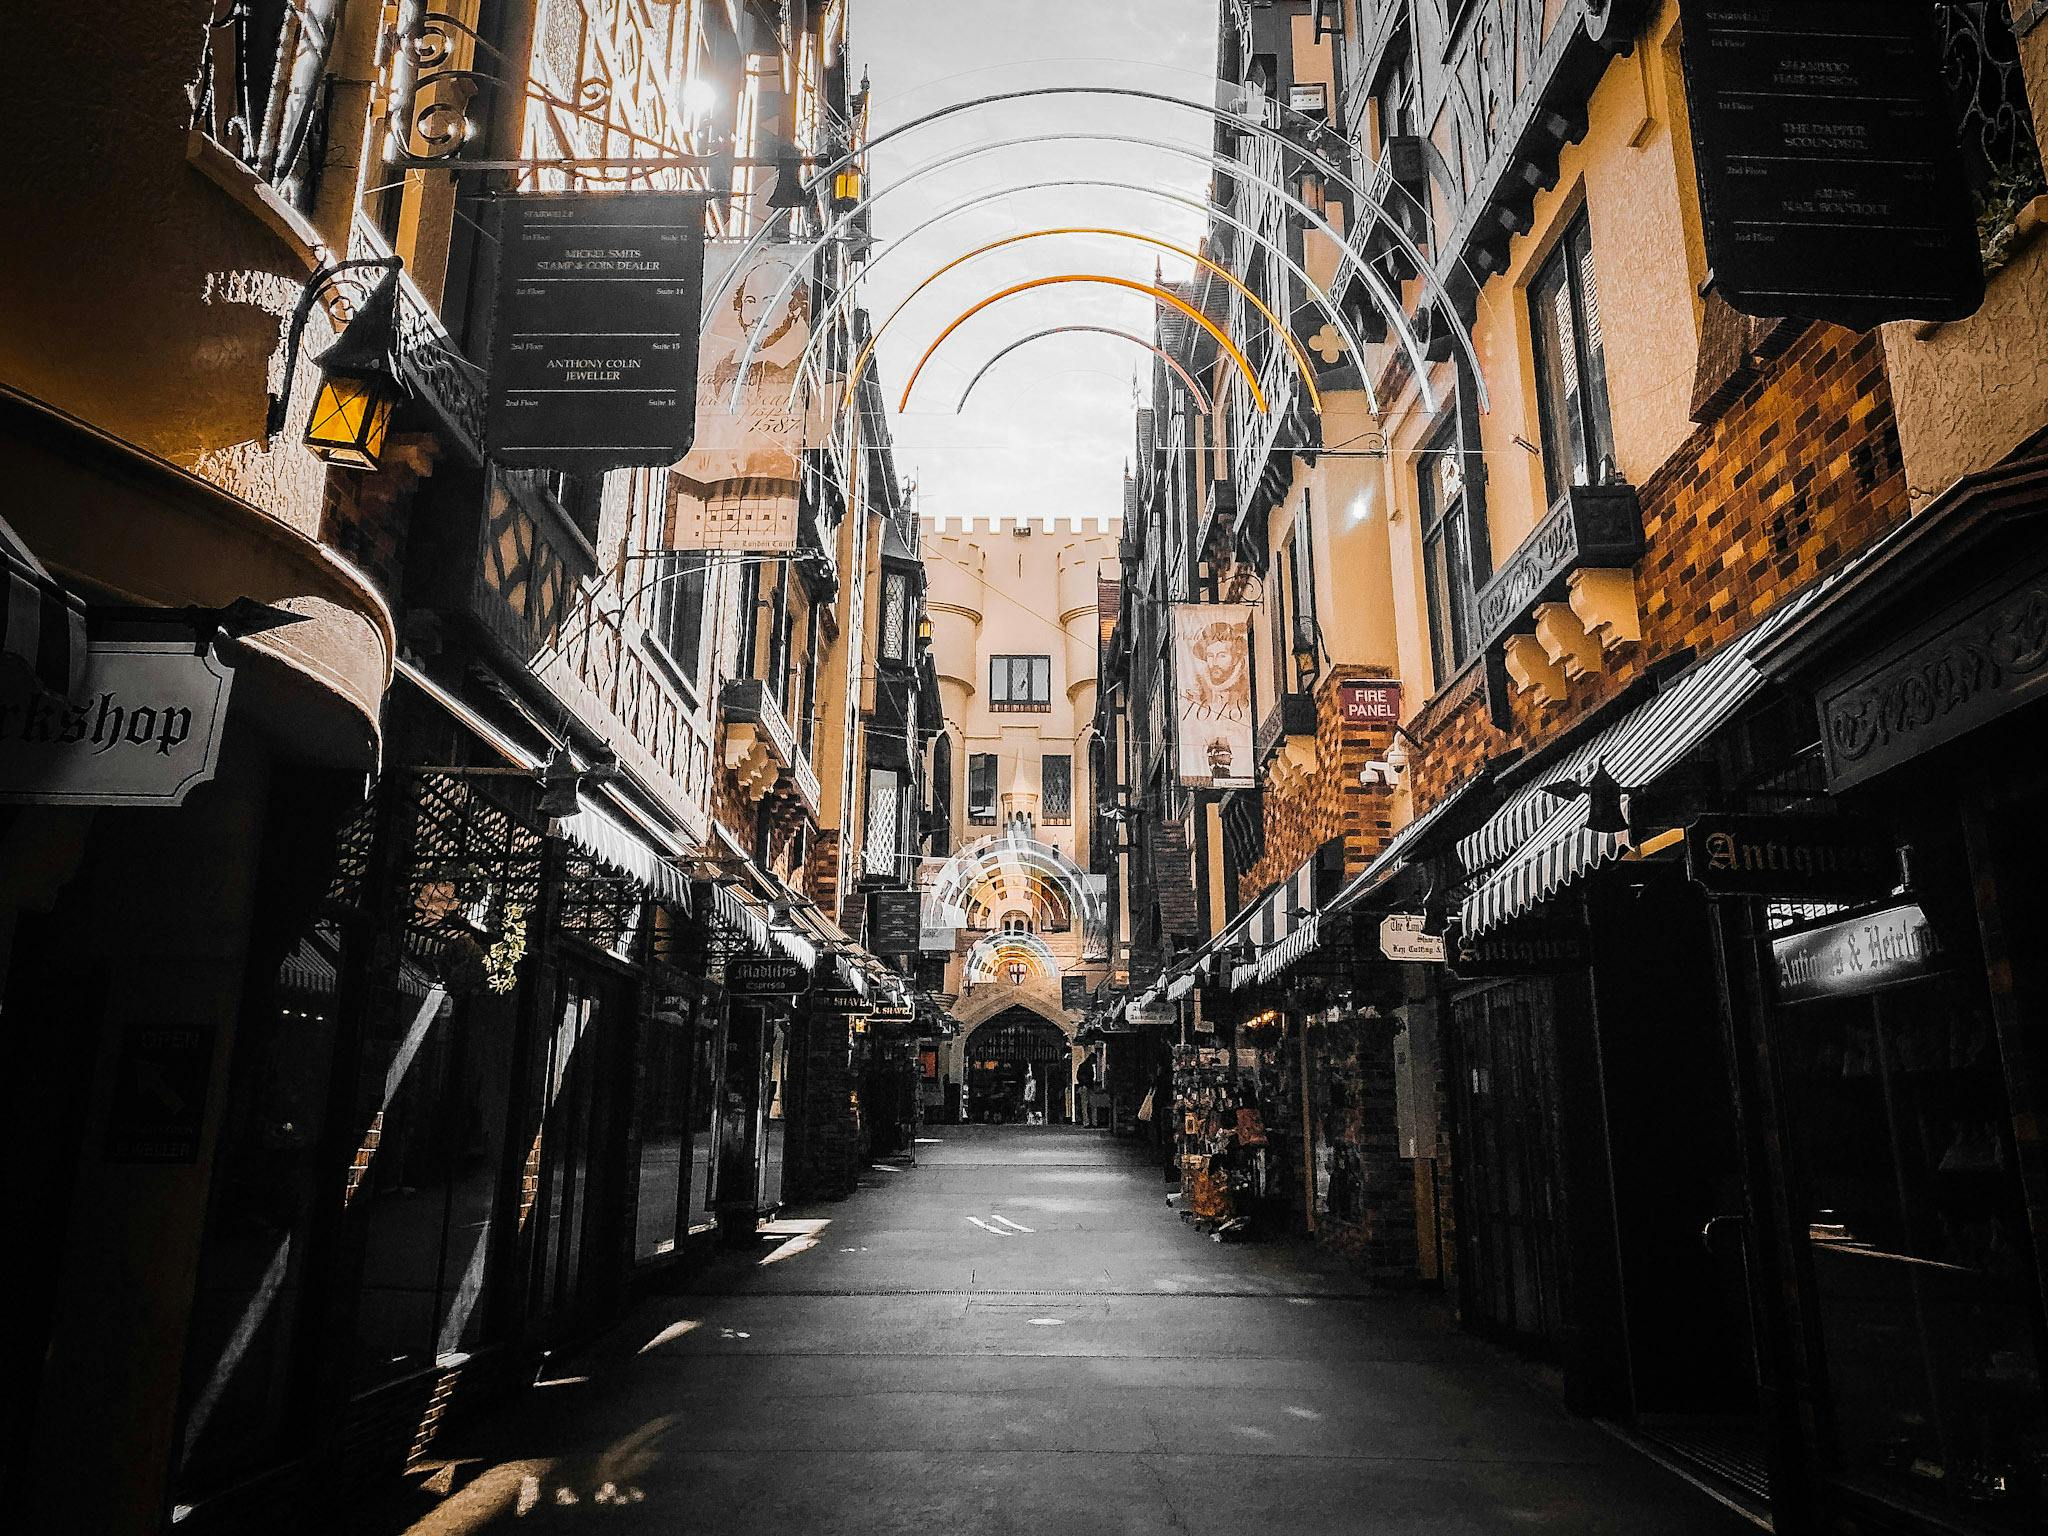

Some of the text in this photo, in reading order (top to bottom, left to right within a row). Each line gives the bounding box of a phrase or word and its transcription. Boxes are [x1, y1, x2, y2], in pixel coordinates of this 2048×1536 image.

[586, 261, 615, 270] COIN
[617, 261, 660, 270] DEALER
[546, 359, 642, 368] ANTHONY COLIN
[566, 371, 621, 381] JEWELLER
[748, 414, 801, 434] 1587
[1355, 690, 1388, 702] FIRE
[1348, 704, 1396, 717] PANEL
[1705, 831, 1879, 879] Antiques
[1391, 919, 1403, 932] The
